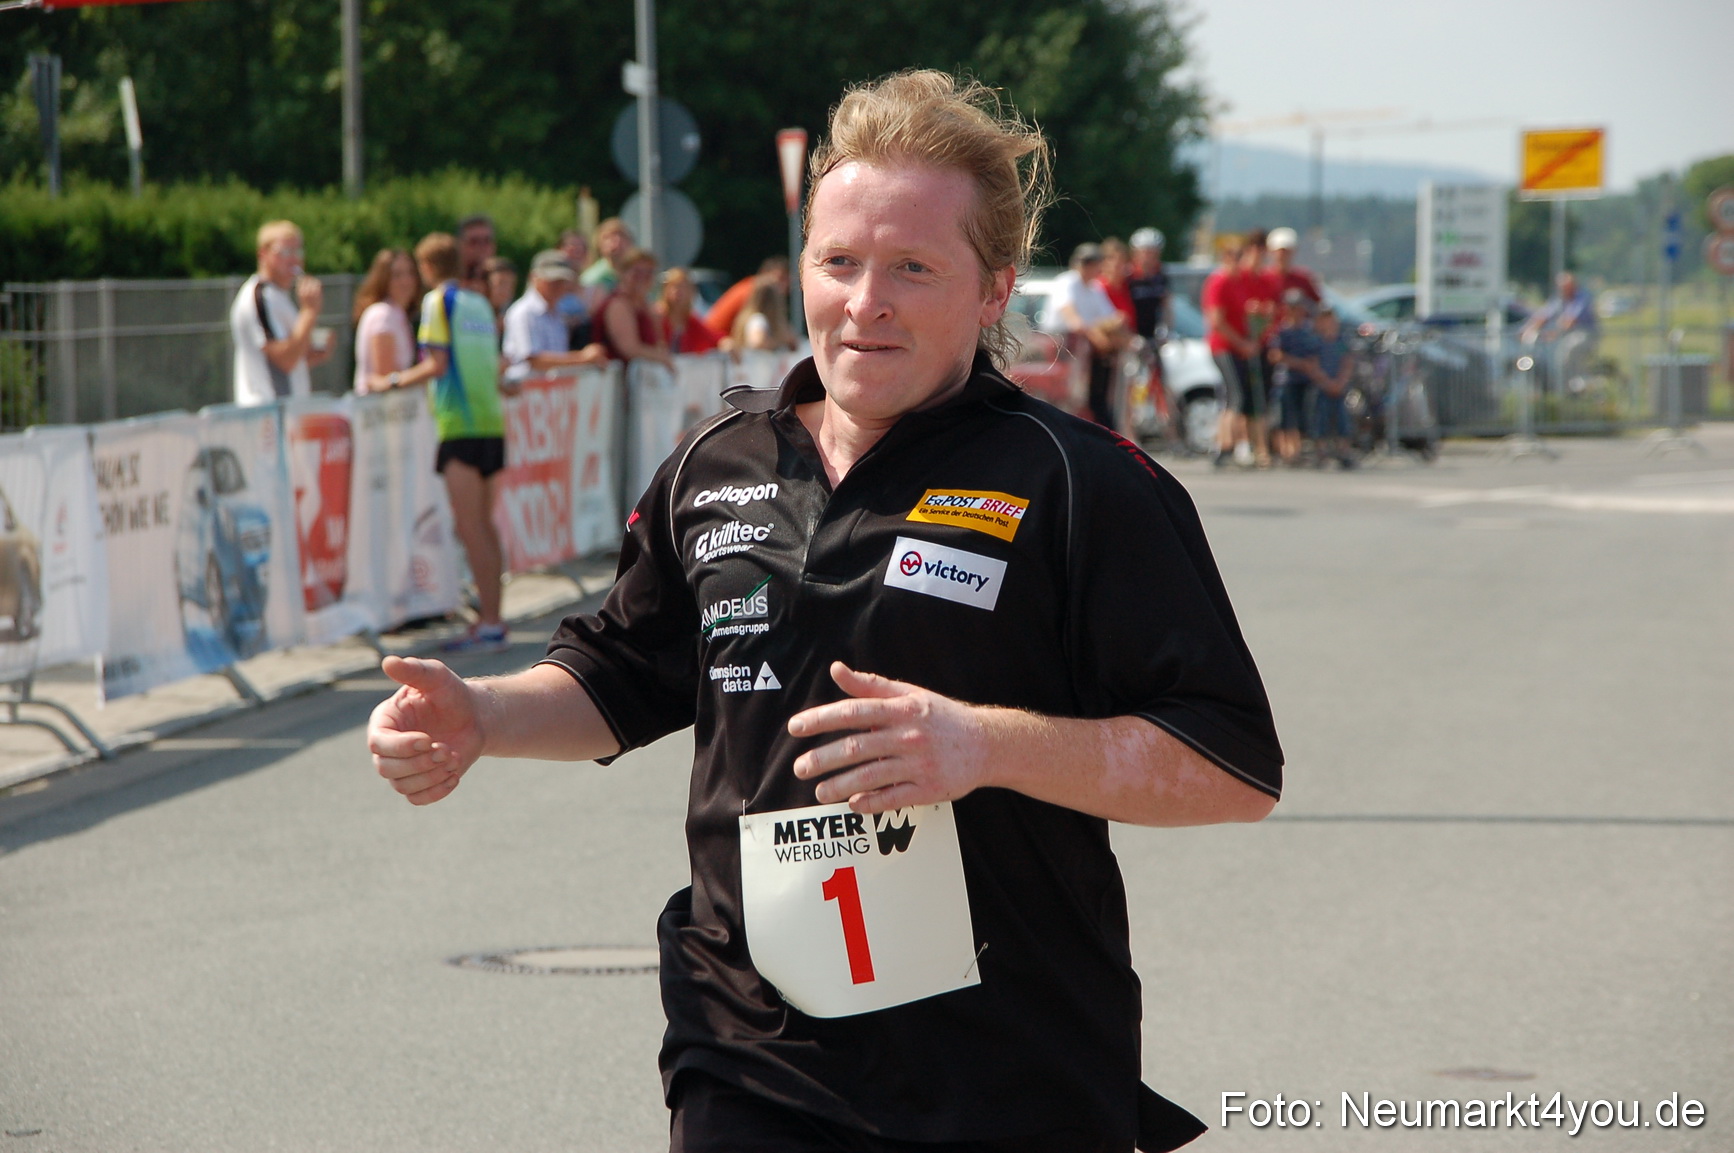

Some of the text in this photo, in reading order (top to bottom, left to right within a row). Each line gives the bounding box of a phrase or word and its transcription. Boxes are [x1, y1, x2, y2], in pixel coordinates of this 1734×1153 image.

[918, 507, 1009, 528] Ein Service der Deutschen Post
[980, 498, 1024, 518] BRIEF
[702, 544, 754, 563] sportswear
[924, 559, 990, 592] victory
[722, 679, 752, 693] data
[773, 813, 867, 846] MEYER
[774, 837, 871, 864] WERBUNG
[821, 866, 876, 985] 1
